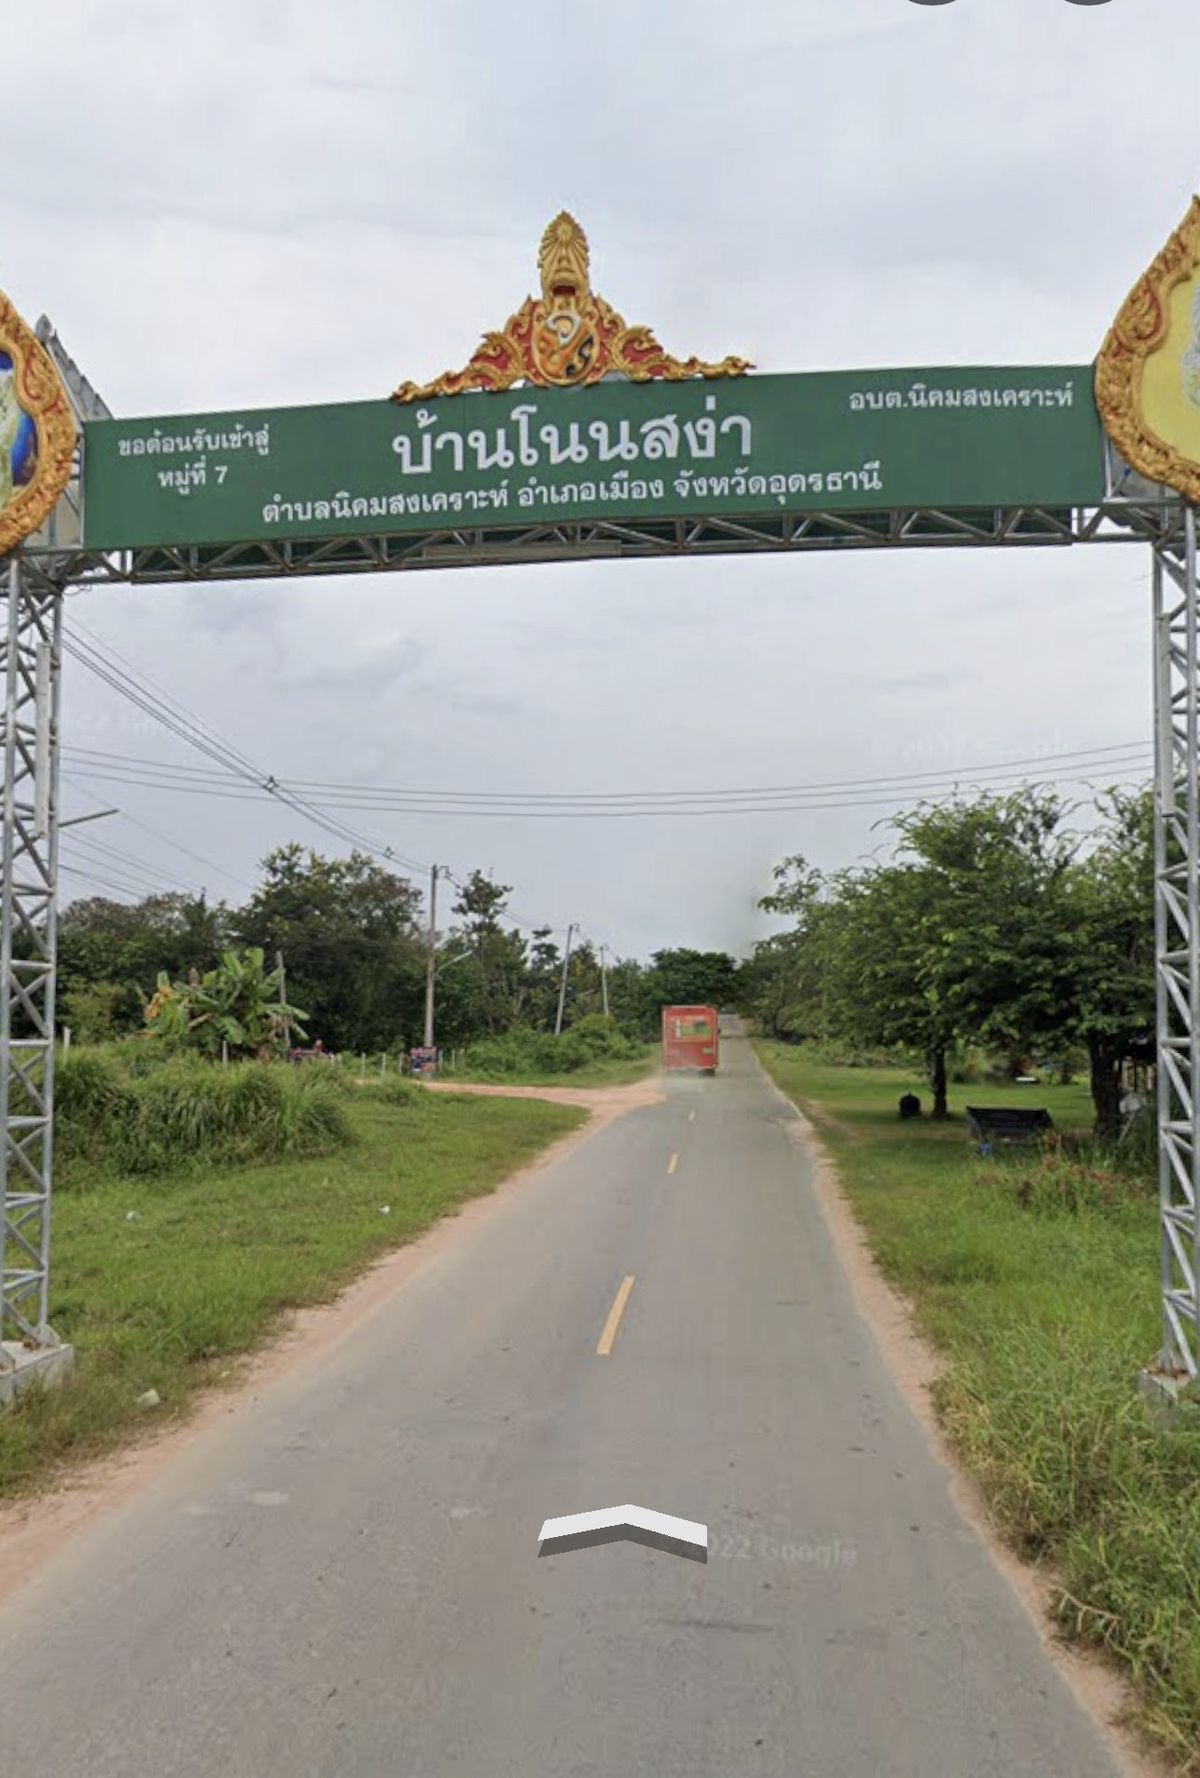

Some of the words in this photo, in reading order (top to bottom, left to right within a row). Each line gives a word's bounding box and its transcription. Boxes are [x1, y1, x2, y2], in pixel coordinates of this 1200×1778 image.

[849, 381, 1073, 410] อบต.นิคมสงเคราะห์
[118, 423, 270, 456] ขอต้อนรับเข้าสู่
[391, 395, 753, 475] บ้านโนนสง่า
[158, 455, 207, 495] หมู่ที่
[214, 465, 228, 484] 7
[262, 479, 509, 523] ตำบลนิคมสงเคราะห์
[517, 470, 665, 507] อำเภอเมือง
[673, 460, 883, 505] จังหวัดอุดรธานี
